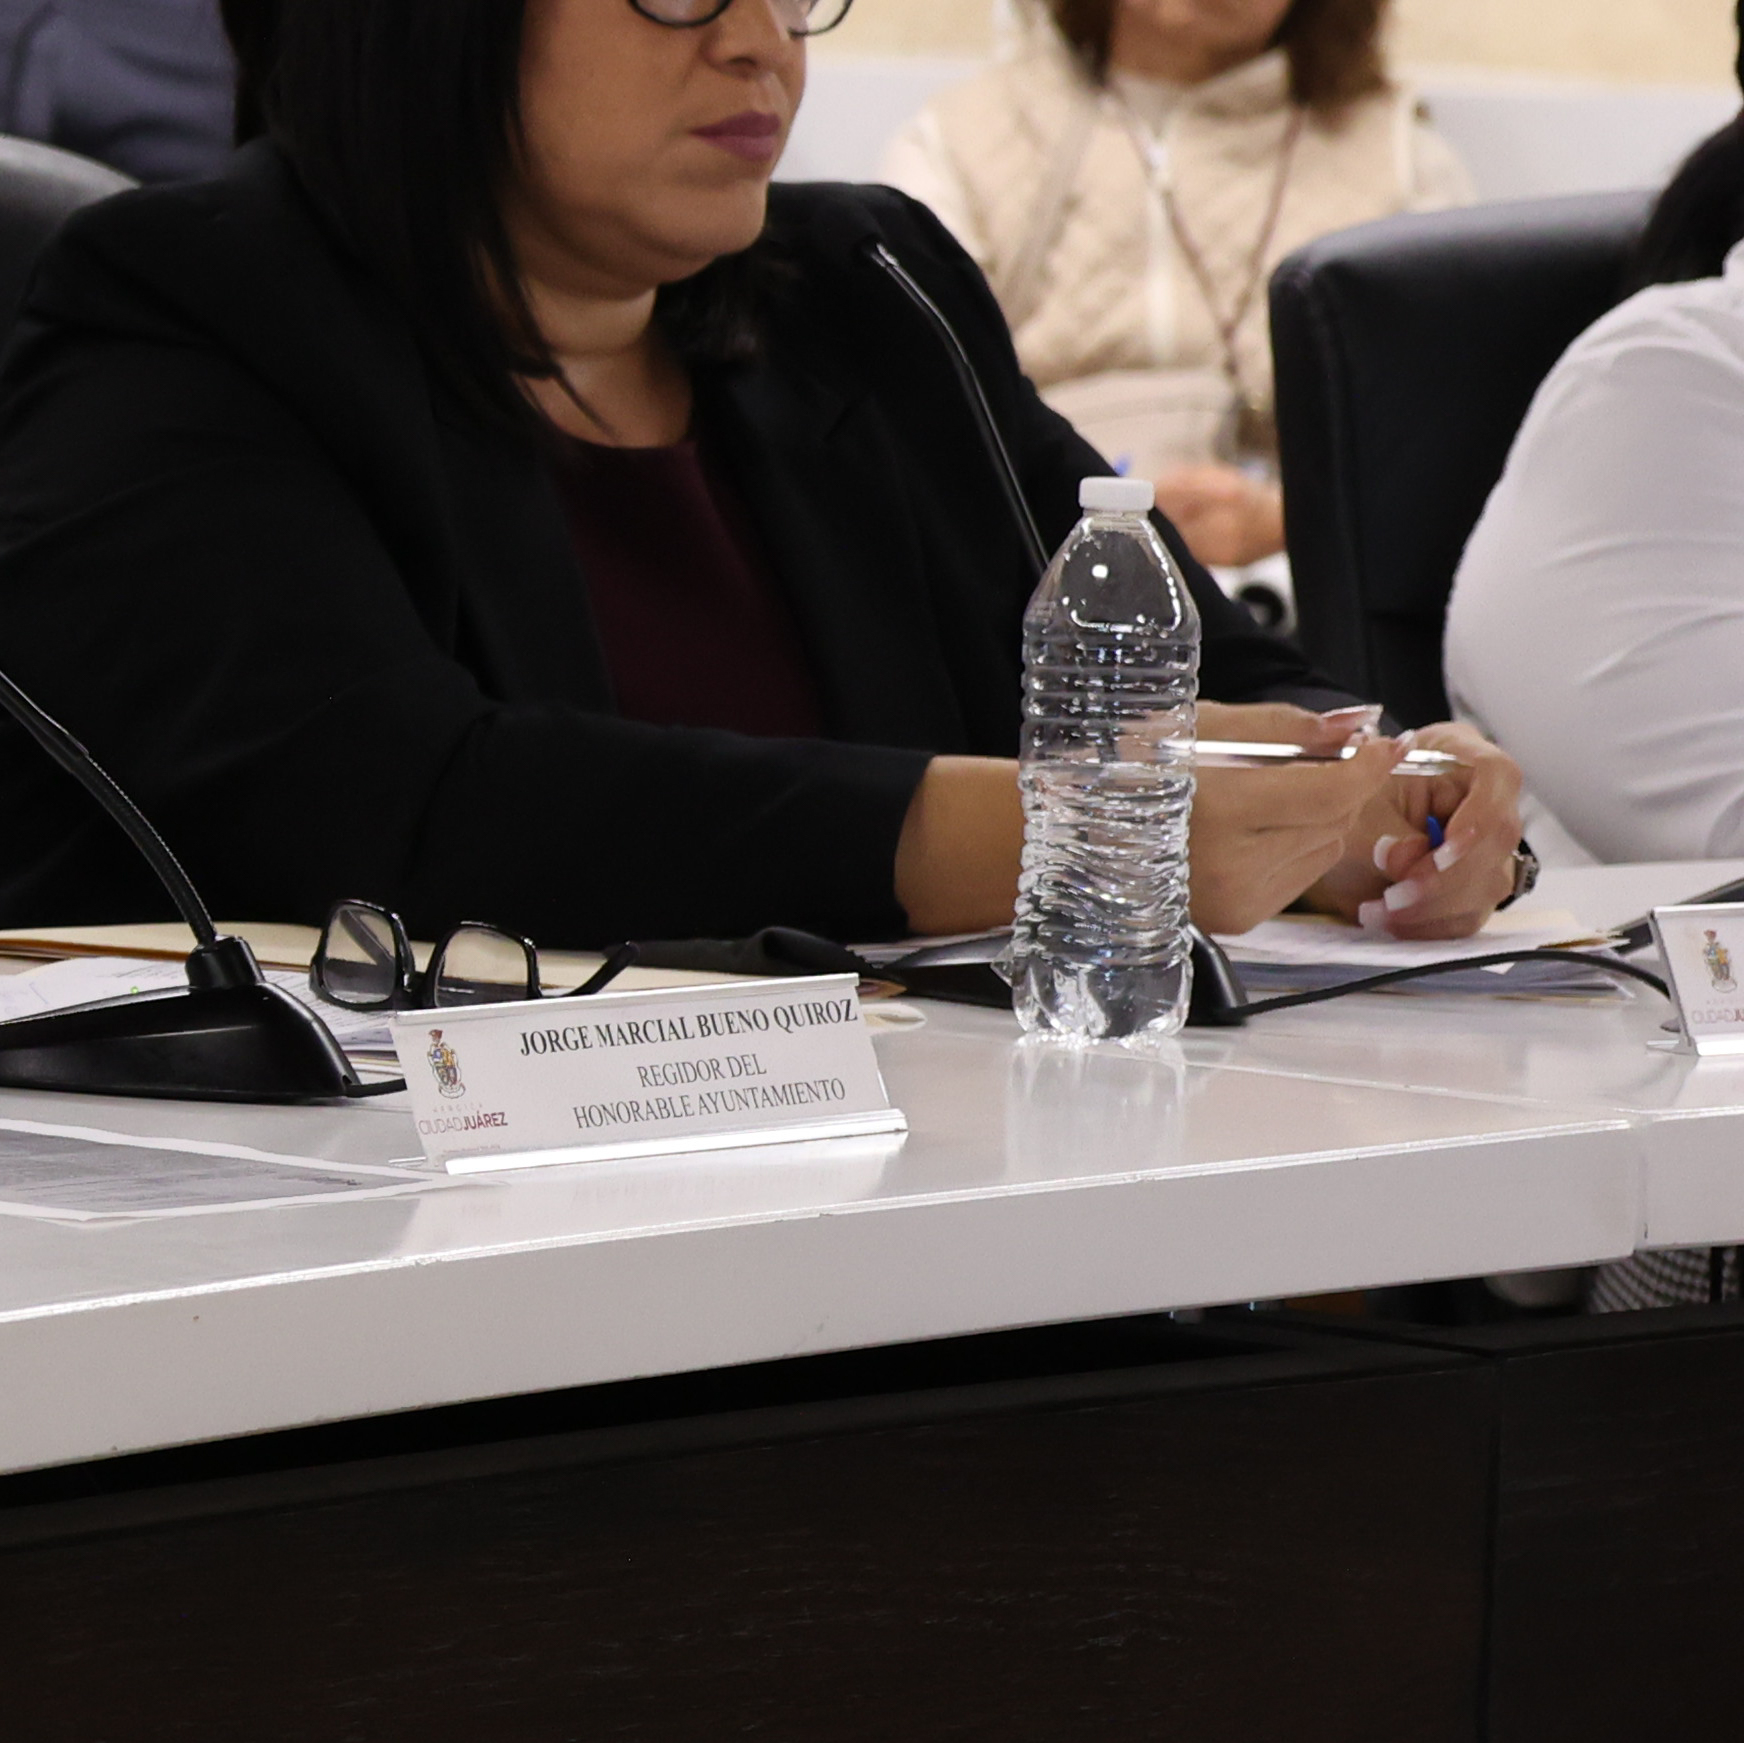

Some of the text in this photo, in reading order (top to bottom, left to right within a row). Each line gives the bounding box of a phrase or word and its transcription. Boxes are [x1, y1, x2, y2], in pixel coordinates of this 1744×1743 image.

[520, 999, 858, 1056] JORGE MARCIAL BUENO QUIROZ
[637, 1054, 767, 1087] REGIDOR DEL
[573, 1078, 845, 1129] HONORABLE AYUNTAMIENTO
